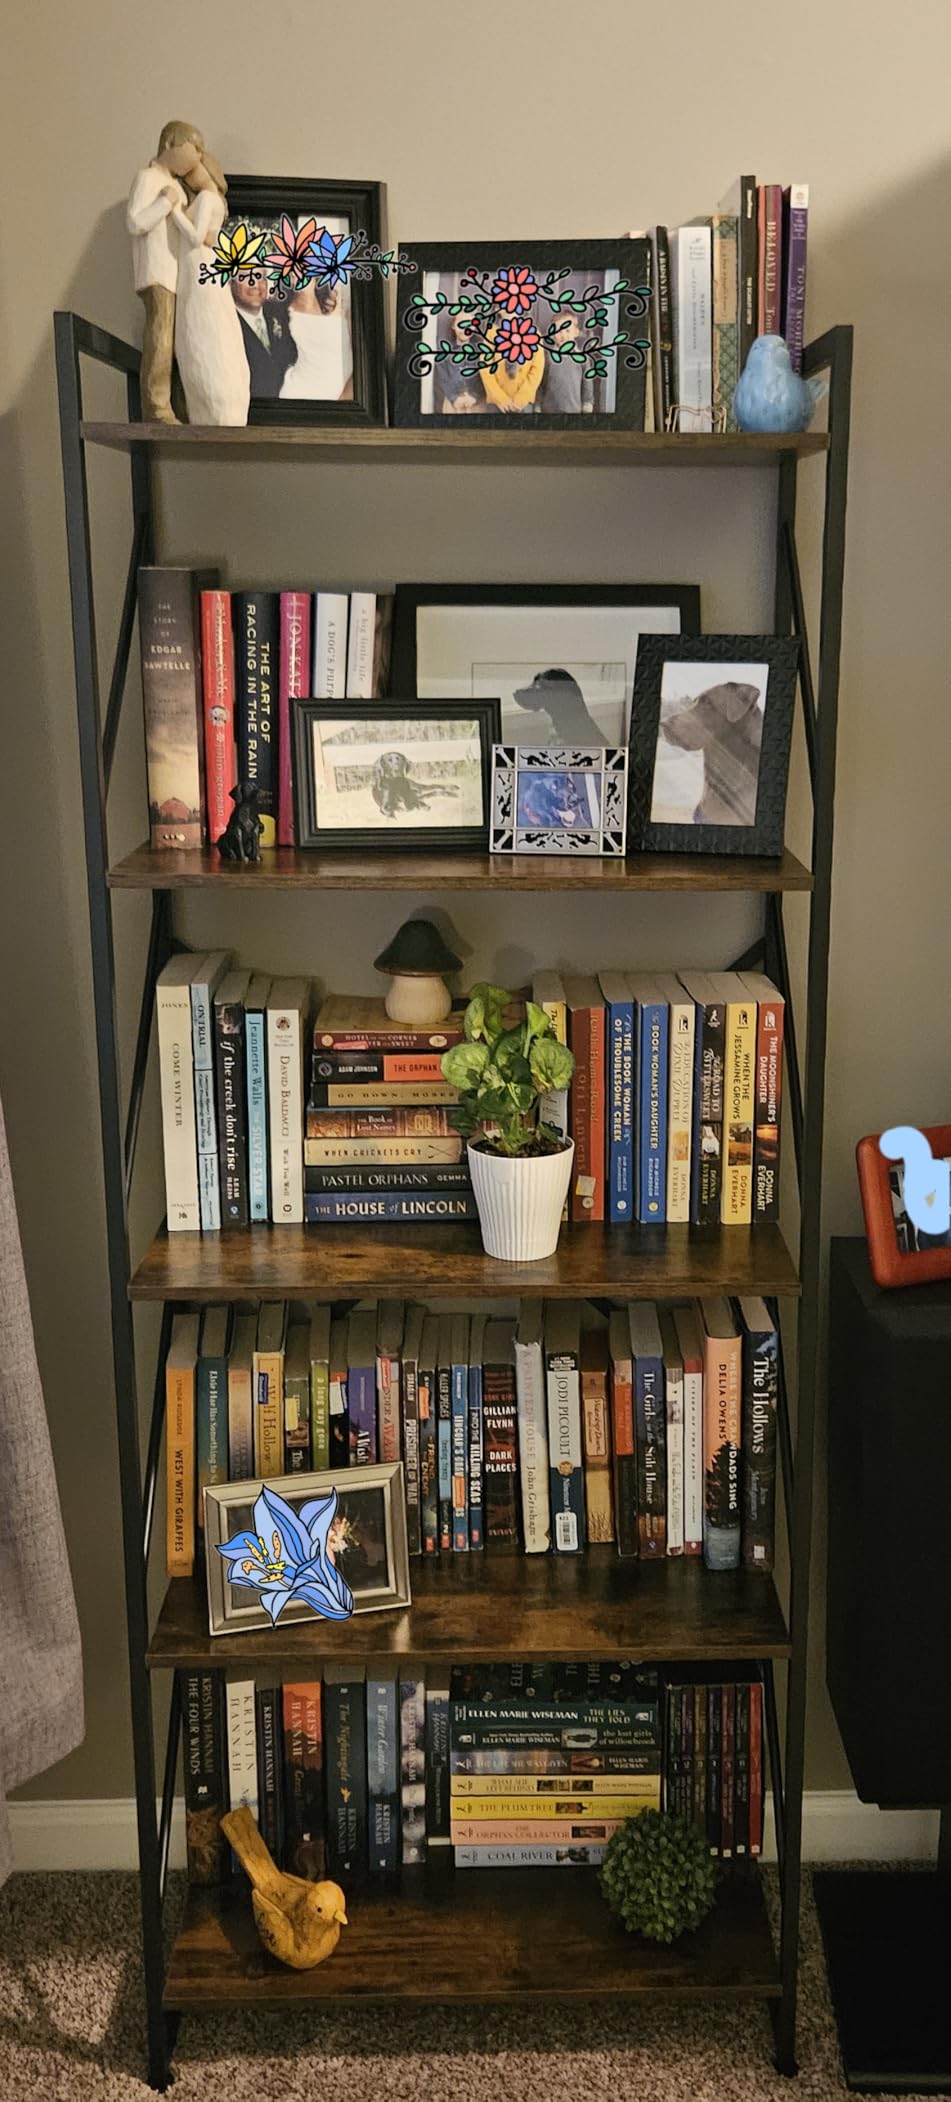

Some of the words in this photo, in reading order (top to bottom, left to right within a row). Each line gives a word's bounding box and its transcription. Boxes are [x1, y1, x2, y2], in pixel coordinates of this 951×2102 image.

[767, 221, 776, 292] BELOVED
[797, 266, 806, 301] TONI
[247, 604, 256, 670] RACING
[288, 612, 302, 650] JON
[151, 646, 182, 654] EDGAR
[260, 643, 270, 673] THE
[327, 631, 336, 664] DOG'S
[144, 662, 191, 671] SAWTELLE
[247, 677, 256, 694] IN
[261, 681, 270, 715] ART
[247, 700, 257, 733] THE
[261, 720, 270, 743] OF
[248, 739, 258, 779] RAIN
[197, 1005, 205, 1020] ON
[614, 1019, 622, 1034] OF
[198, 1022, 206, 1047] TRIAL
[220, 1041, 233, 1055] if
[249, 1020, 262, 1075] Jeannette
[623, 1033, 632, 1052] THE
[651, 1025, 659, 1053] BOOK
[769, 1037, 777, 1053] THE
[172, 1043, 181, 1075] COME
[224, 1056, 235, 1076] the
[279, 1056, 290, 1087] DAVID
[394, 1064, 406, 1072] THE
[409, 1064, 437, 1072] ORPHAN
[613, 1037, 622, 1107] TROUBLESOME
[623, 1056, 632, 1084] BOOK
[733, 1034, 743, 1084] JESSAMINE
[742, 1053, 750, 1080] WHEN
[251, 1076, 264, 1105] Walls
[650, 1055, 659, 1098] WOMAN'S
[702, 1048, 713, 1120] BITTERSWEET
[742, 1083, 750, 1100] THE
[759, 1056, 768, 1104] DAUGHTER
[767, 1055, 777, 1122] MOONSHINER'S
[175, 1081, 183, 1127] WINTER
[224, 1079, 236, 1110] creek
[623, 1088, 631, 1125] WOMAN
[733, 1086, 742, 1119] GROWS
[281, 1090, 291, 1136] BALDACCI
[614, 1111, 622, 1142] CREEK
[650, 1100, 658, 1149] DAUGHTER
[225, 1115, 237, 1143] don't
[226, 1147, 238, 1170] rise
[322, 1175, 364, 1186] PASTEL
[369, 1175, 428, 1185] ORPHANS
[701, 1163, 710, 1205] EVERHART
[730, 1169, 739, 1214] EVERHART
[757, 1165, 766, 1211] EVERHART
[765, 1170, 774, 1204] DONNA
[315, 1206, 331, 1214] THE
[336, 1203, 385, 1215] HOUSE
[390, 1204, 399, 1213] of
[402, 1201, 467, 1215] LINCOLN
[644, 1372, 656, 1392] The
[718, 1364, 727, 1396] DELIA
[729, 1351, 737, 1391] WHERE
[753, 1357, 770, 1387] The
[316, 1387, 327, 1406] long
[556, 1375, 569, 1403] JODI
[316, 1409, 325, 1426] way
[484, 1406, 516, 1416] GILLIAN
[645, 1394, 657, 1421] Girls
[718, 1400, 727, 1439] OWENS
[729, 1395, 737, 1416] THE
[316, 1428, 326, 1449] gone
[487, 1419, 514, 1428] FLYNN
[558, 1405, 570, 1457] PICOULT
[752, 1392, 770, 1454] Hollows
[406, 1419, 417, 1470] PRISONER
[489, 1451, 512, 1460] DARK
[645, 1446, 656, 1468] Stilt
[175, 1450, 183, 1476] WEST
[470, 1444, 481, 1478] KILLING
[485, 1463, 517, 1472] PLACES
[175, 1479, 184, 1504] WITH
[470, 1480, 481, 1503] SEAS
[527, 1465, 537, 1490] John
[646, 1472, 657, 1504] House
[407, 1482, 417, 1505] WAR
[729, 1482, 737, 1510] SING
[175, 1508, 184, 1552] GIRAFFES
[527, 1493, 538, 1536] Grisham
[188, 1677, 198, 1699] THE
[202, 1678, 213, 1721] KRISTIN
[189, 1703, 199, 1734] FOUR
[264, 1706, 273, 1747] KRISTIN
[292, 1701, 303, 1756] HANNAH
[306, 1700, 318, 1755] KRISTIN
[468, 1710, 497, 1718] ELLEN
[531, 1711, 578, 1719] WISEMAN
[231, 1697, 241, 1772] HANNAH
[243, 1695, 254, 1771] KRISTIN
[190, 1737, 201, 1775] WINDS
[203, 1724, 214, 1775] HANNAH
[264, 1749, 274, 1792] HANNAH
[488, 1852, 517, 1860] COAL
[521, 1852, 553, 1860] RIVER
